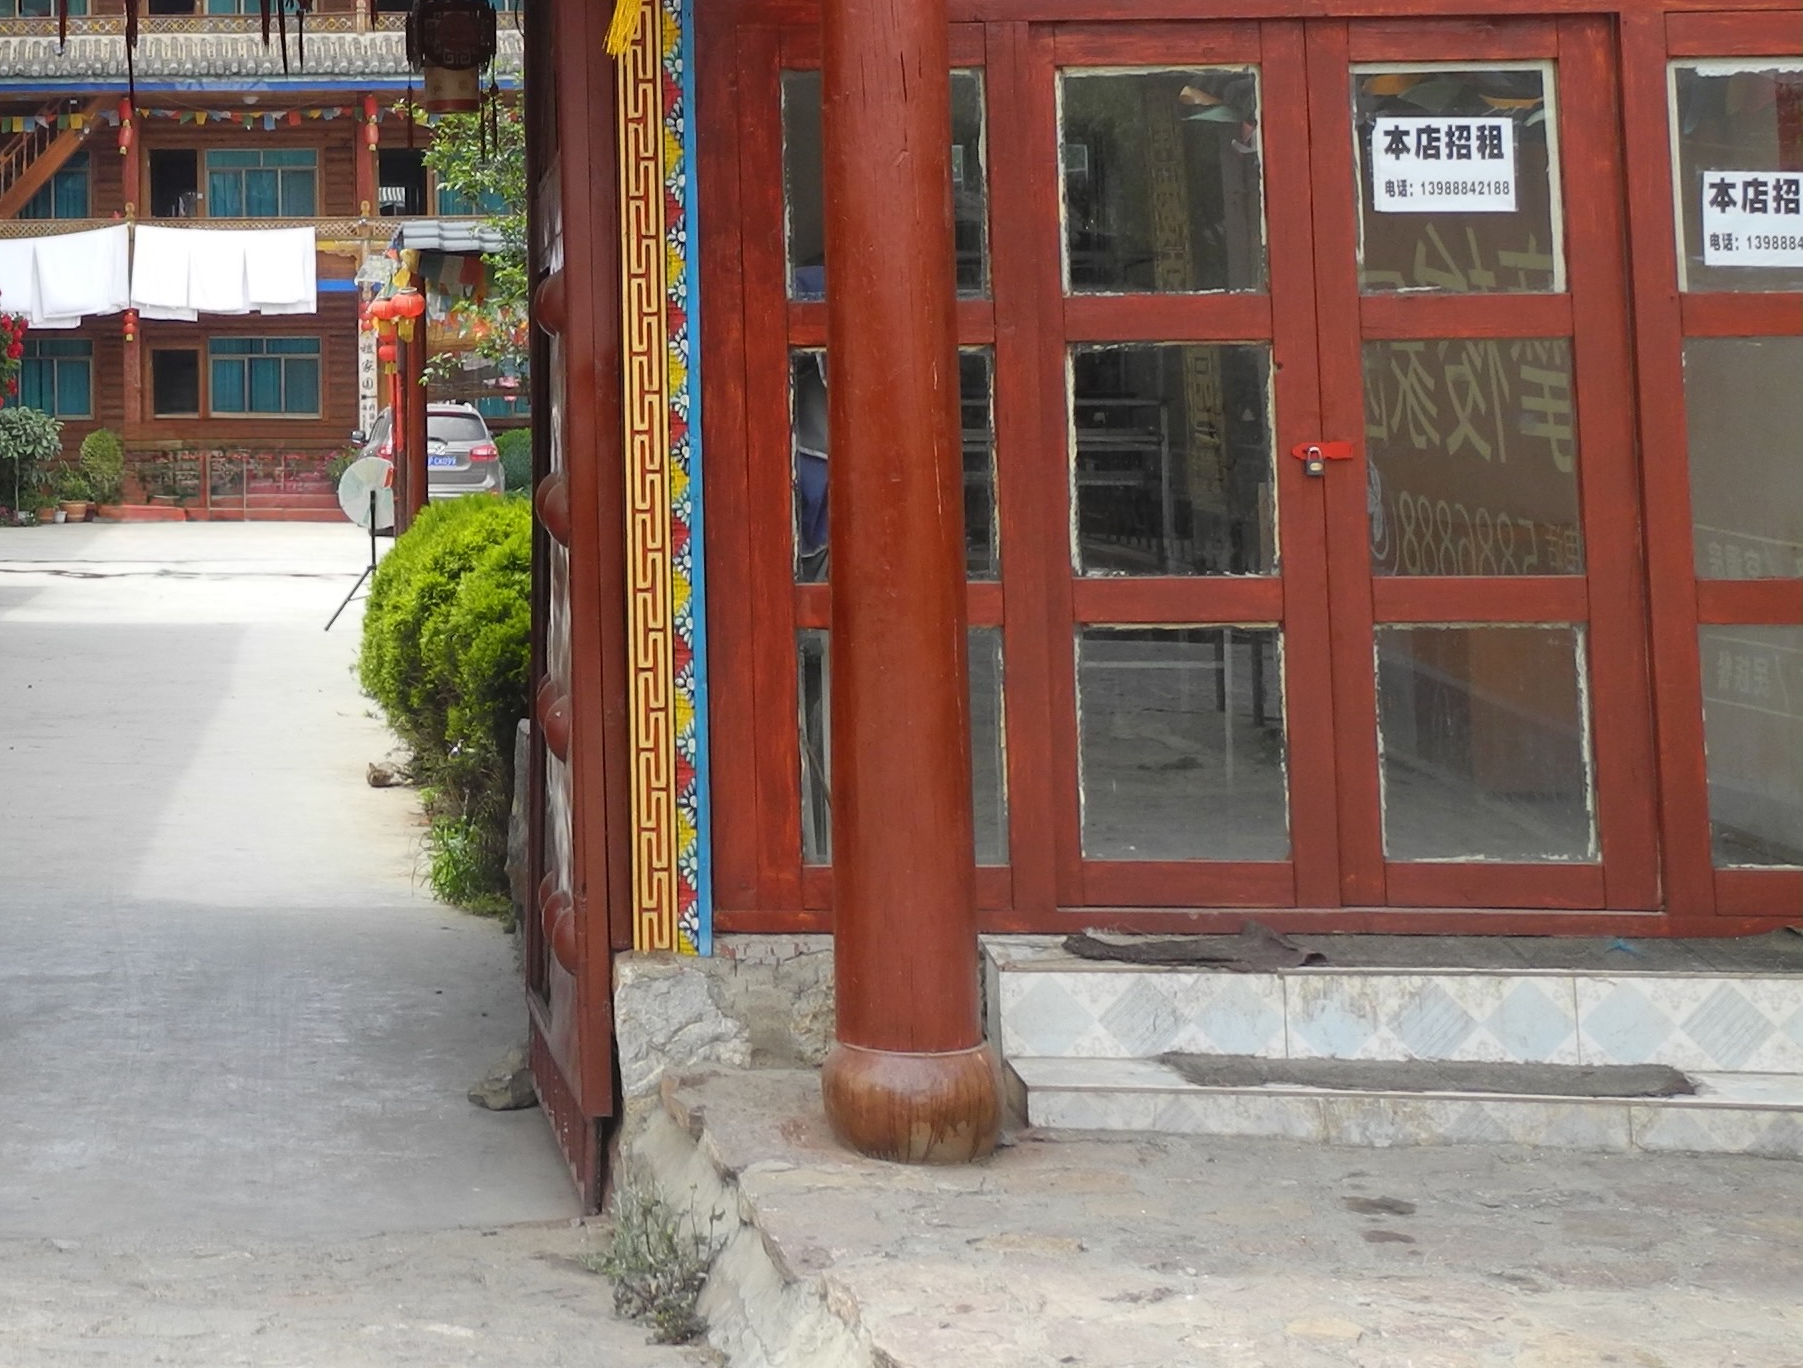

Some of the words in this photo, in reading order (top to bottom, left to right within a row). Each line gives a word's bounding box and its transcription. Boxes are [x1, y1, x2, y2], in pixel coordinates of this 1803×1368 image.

[1383, 124, 1505, 161] 本店招租
[1384, 179, 1414, 198] 电话：
[1420, 180, 1511, 196] 13988842188
[1708, 177, 1801, 215] 本店招
[1709, 232, 1739, 252] 电话：
